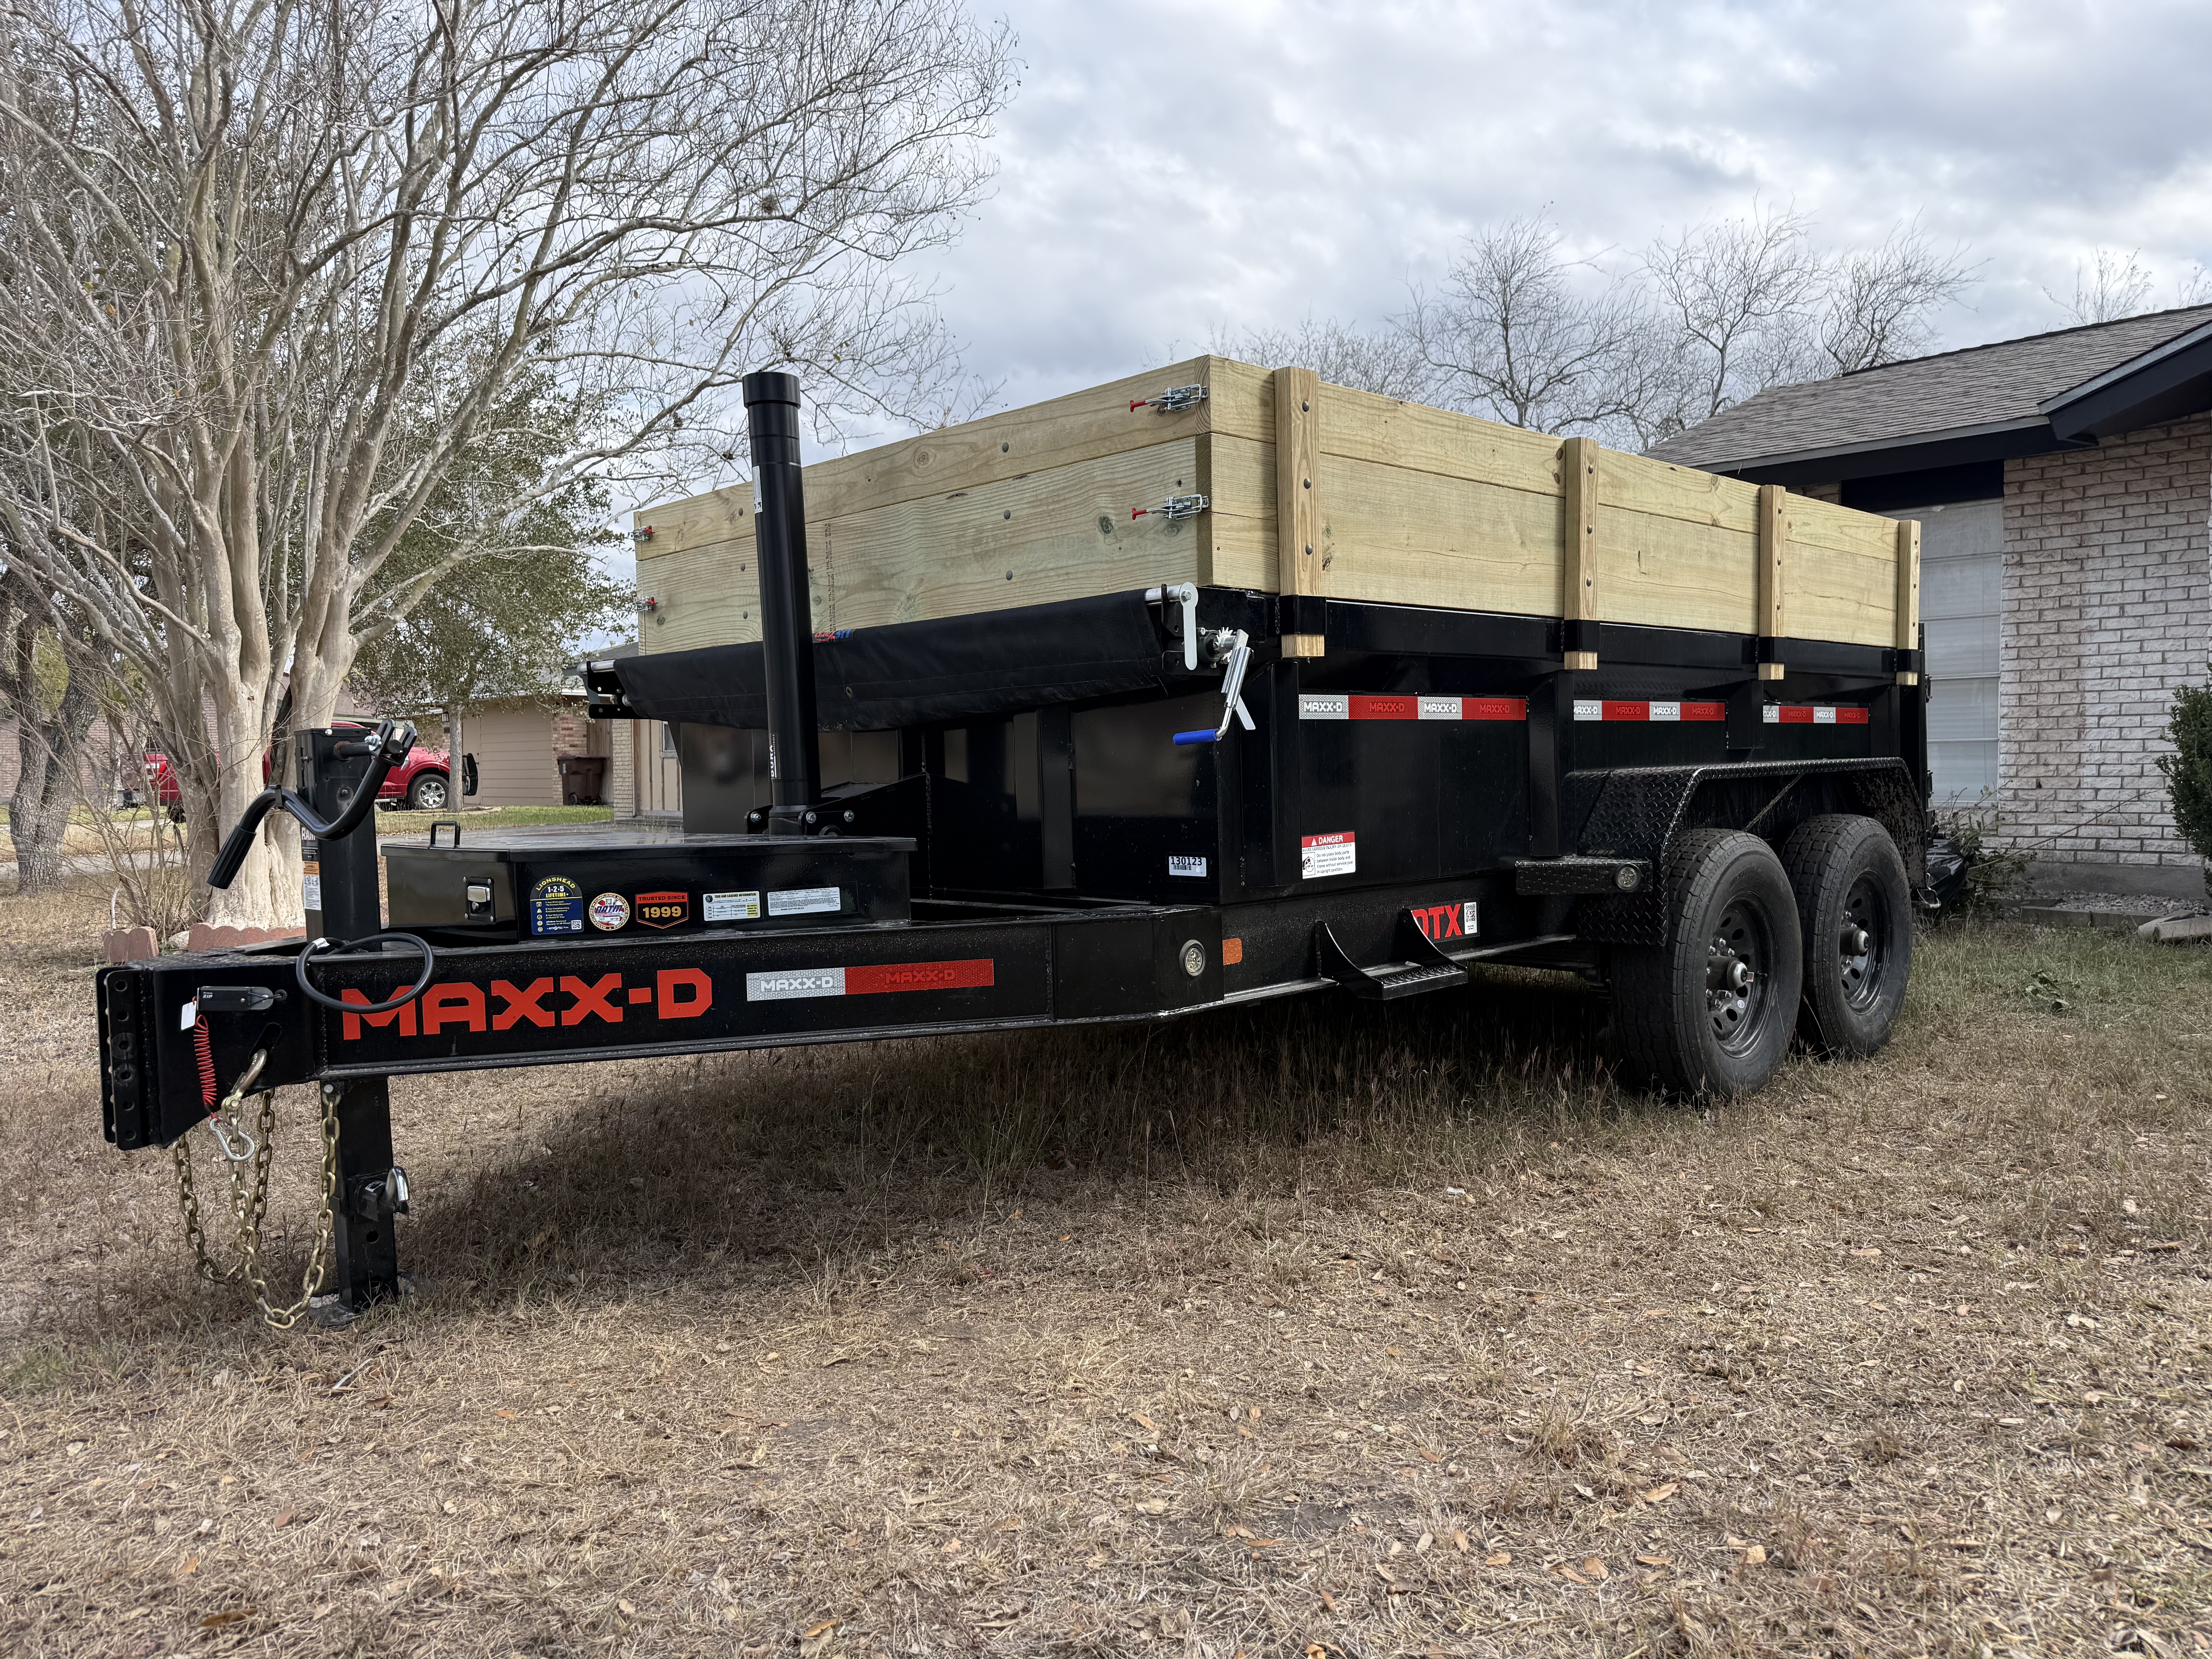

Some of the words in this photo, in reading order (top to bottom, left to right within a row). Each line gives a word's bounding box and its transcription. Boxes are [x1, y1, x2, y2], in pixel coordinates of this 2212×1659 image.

[1304, 702, 1343, 712] MAXX-D
[1369, 702, 1405, 712] MAXX-D
[1424, 703, 1457, 713] MAXX-D
[1479, 704, 1510, 714] MAXX-D
[1616, 706, 1641, 715] MAXX-D
[1653, 707, 1677, 715] MAXX-D
[1319, 835, 1343, 844] DANGER
[1171, 857, 1202, 866] 130123
[536, 877, 575, 891] LIONSHEAD
[643, 906, 682, 918] 1999
[1412, 903, 1462, 939] DTX
[761, 977, 833, 992] MAXX-D
[886, 969, 955, 984] MAXX-D
[342, 968, 712, 1040] MAXX-D
